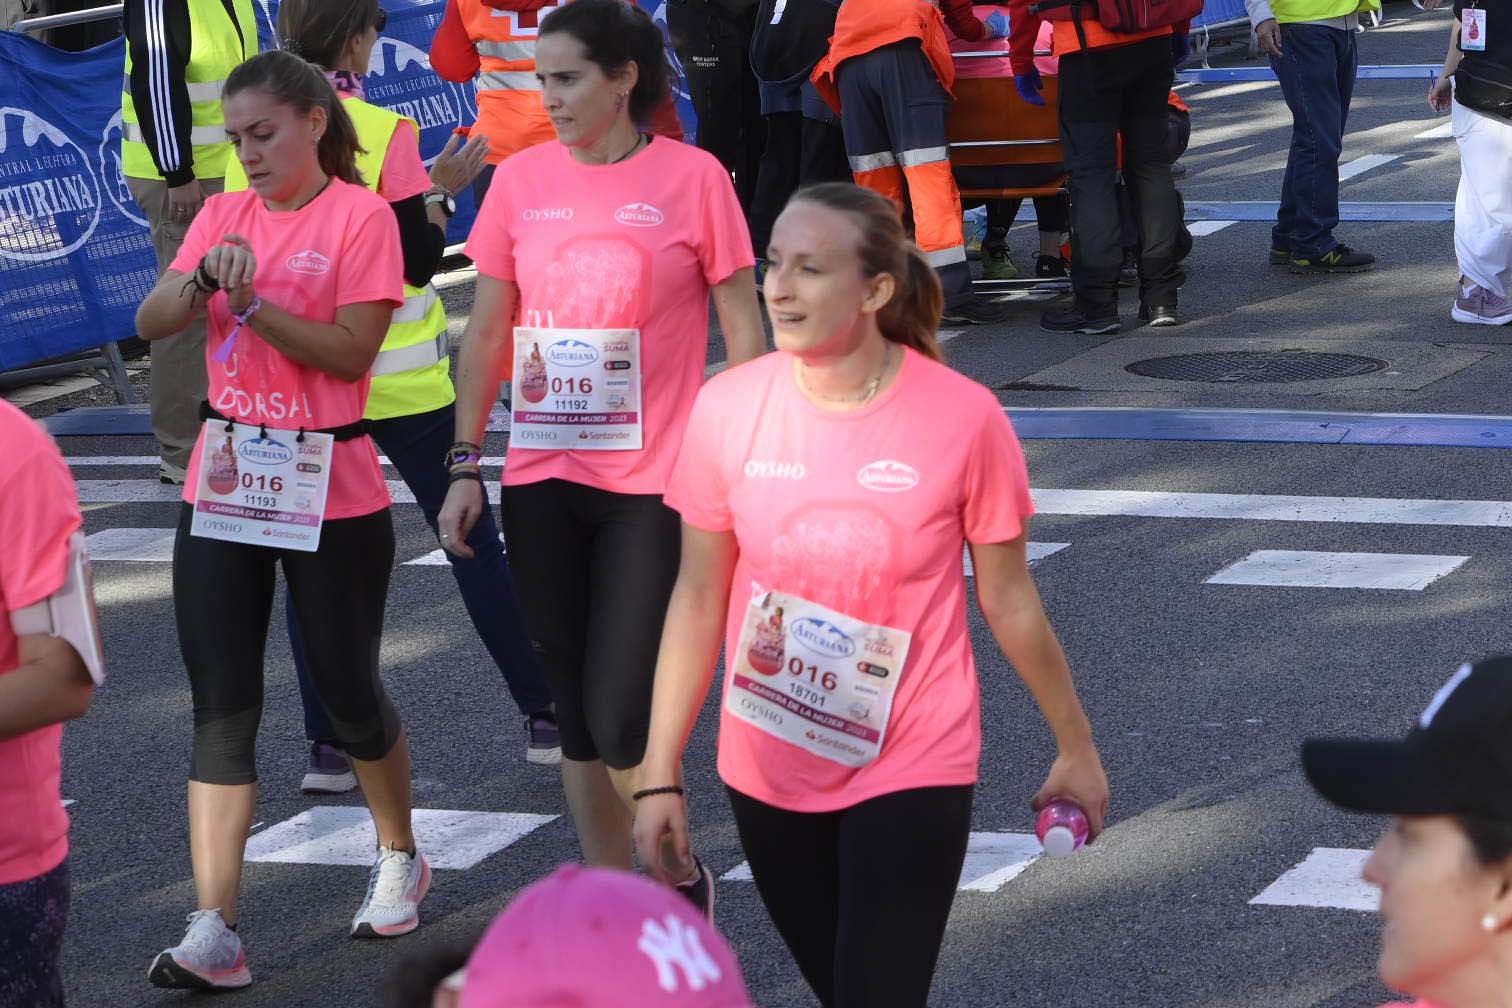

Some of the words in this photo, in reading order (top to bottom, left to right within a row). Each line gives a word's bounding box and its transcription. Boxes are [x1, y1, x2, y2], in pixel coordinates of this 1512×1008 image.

[522, 207, 574, 222] OYSHO
[551, 377, 593, 394] 016
[554, 400, 589, 410] 11192
[525, 414, 556, 422] CARRERA
[556, 414, 567, 422] DE
[568, 414, 579, 422] LA
[580, 414, 607, 423] MUJER
[521, 431, 557, 440] OYSHO
[588, 431, 630, 440] Santander
[241, 444, 289, 460] ASTURIANA
[743, 459, 806, 480] OYSHO
[241, 472, 284, 492] 016
[244, 494, 277, 507] 11193
[209, 504, 244, 516] CARRERA
[245, 509, 255, 517] DE
[255, 510, 266, 518] LA
[203, 519, 242, 533] OYSHO
[272, 529, 311, 540] Santander
[793, 624, 850, 655] ASTURIANA
[788, 657, 839, 691] 016
[789, 682, 826, 707] 18701
[739, 696, 784, 726] OYSHO
[747, 682, 788, 707] CARRERA
[787, 699, 800, 712] DE
[800, 704, 813, 718] LA
[813, 709, 844, 730] MUJER
[817, 733, 866, 758] Santander
